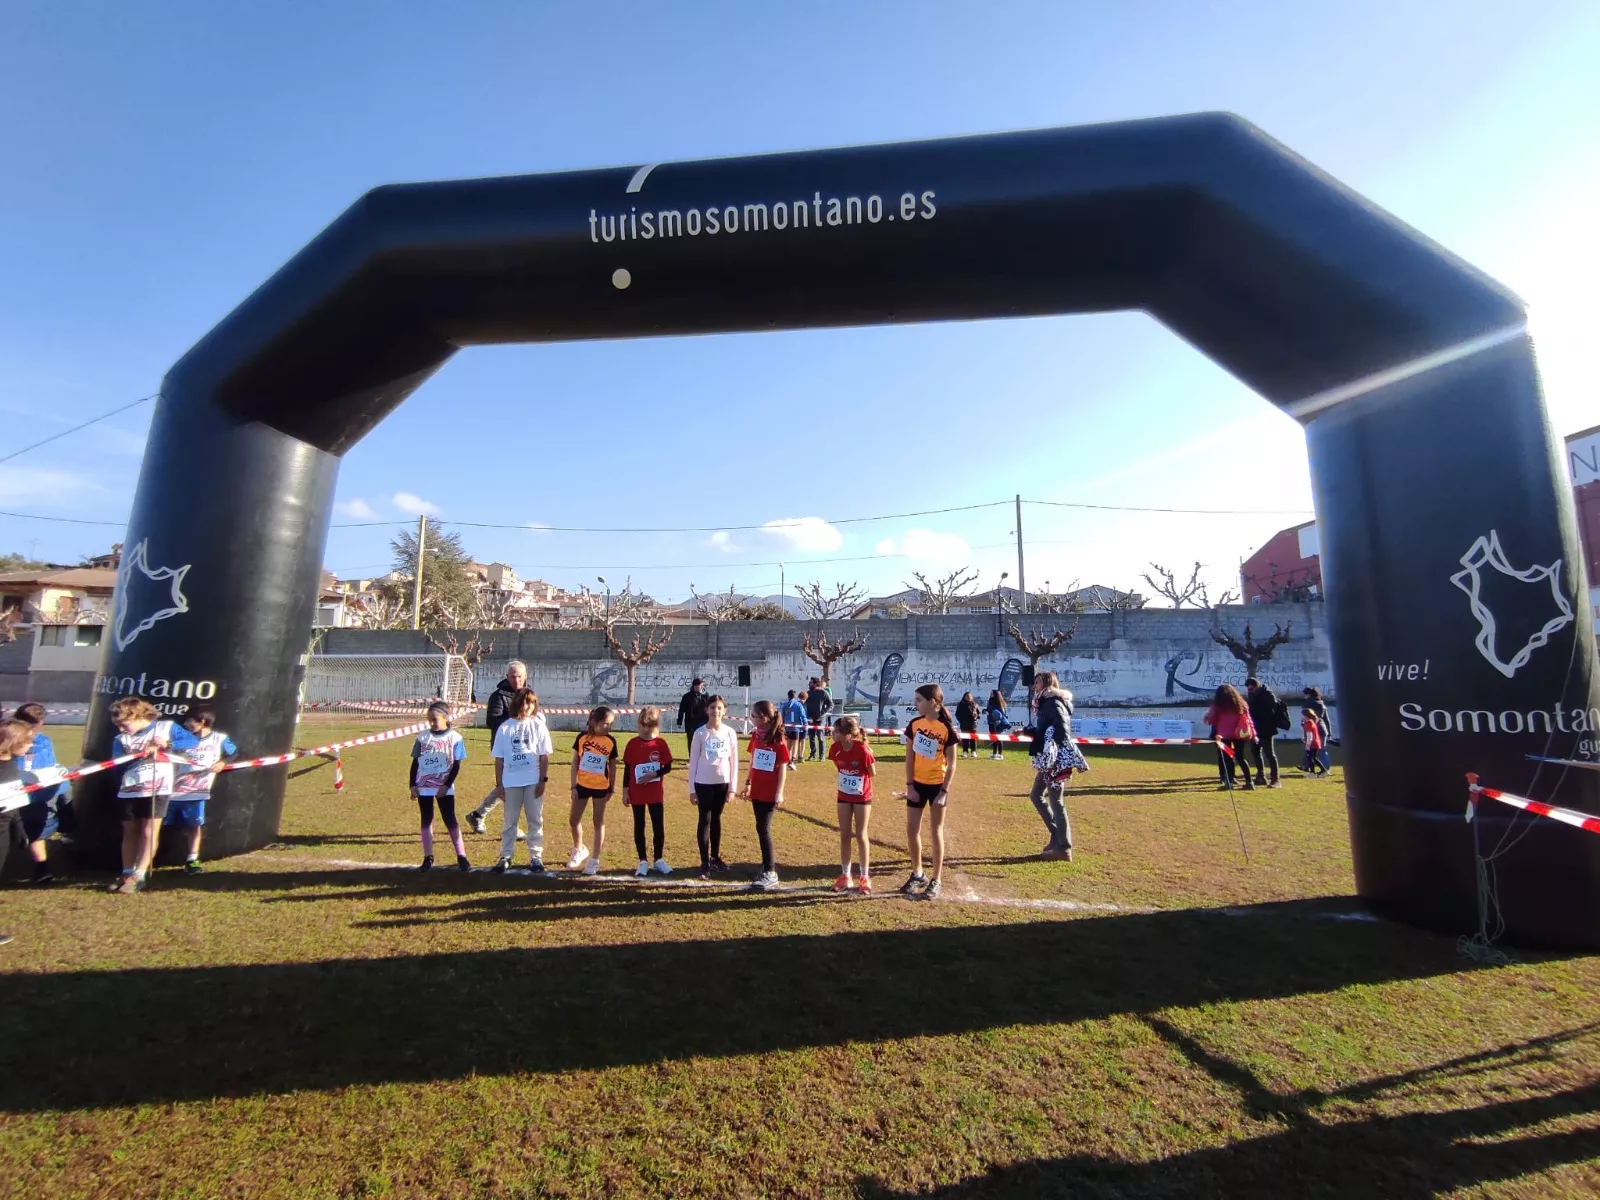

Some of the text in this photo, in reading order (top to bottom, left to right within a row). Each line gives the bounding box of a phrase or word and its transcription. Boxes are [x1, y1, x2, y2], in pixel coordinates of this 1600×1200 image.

[588, 190, 937, 244] turismosomontano.es
[1377, 659, 1430, 681] vive!
[918, 736, 932, 748] 303
[424, 756, 439, 766] 254
[587, 755, 602, 764] 229
[756, 752, 770, 761] 273
